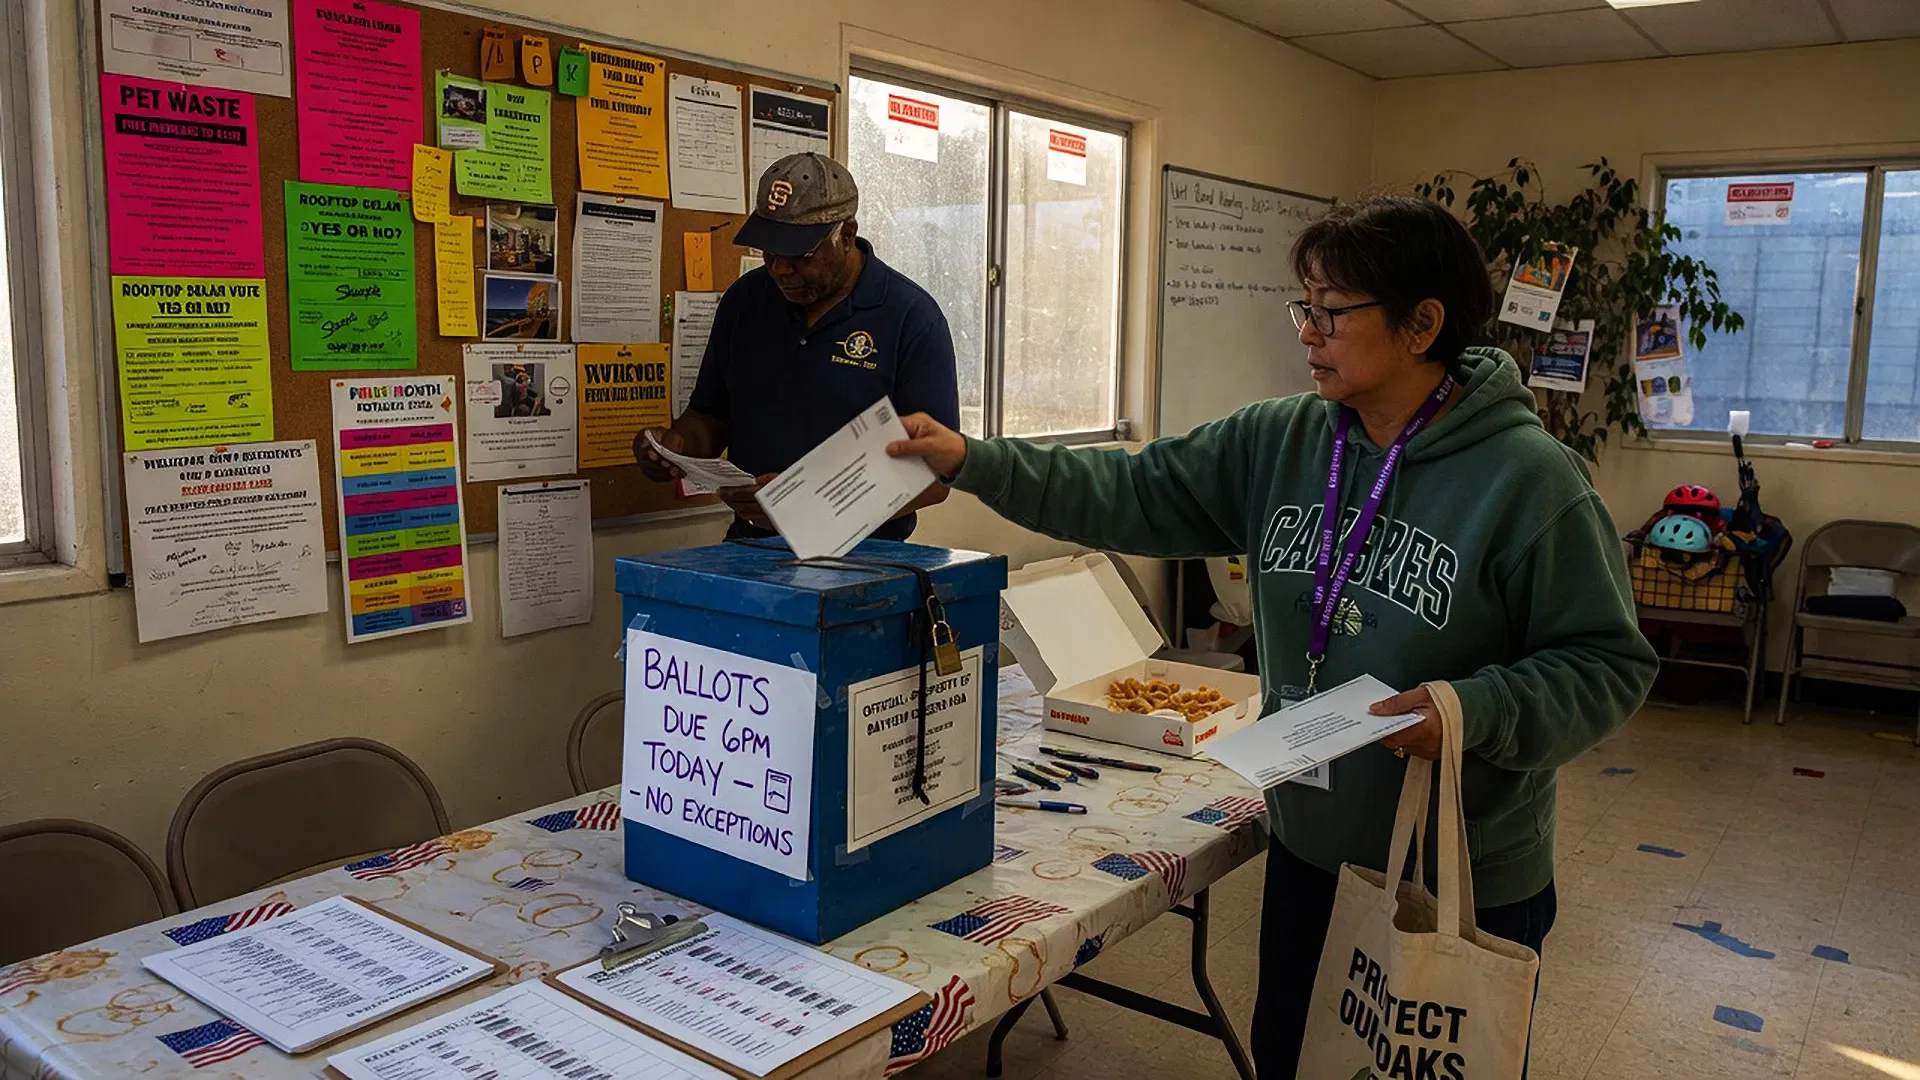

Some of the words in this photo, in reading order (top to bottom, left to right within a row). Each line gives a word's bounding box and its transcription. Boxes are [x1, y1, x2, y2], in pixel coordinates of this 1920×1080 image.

[120, 84, 161, 111] PET
[167, 90, 241, 119] WASTE
[644, 648, 770, 715] BALLOTS
[664, 705, 707, 740] DUE
[722, 717, 771, 759] 6PM
[643, 742, 724, 796] TODAY
[683, 799, 794, 857] EXCEPTIONS
[1347, 947, 1468, 1044] PROTECT
[1375, 1032, 1466, 1080] OAKS
